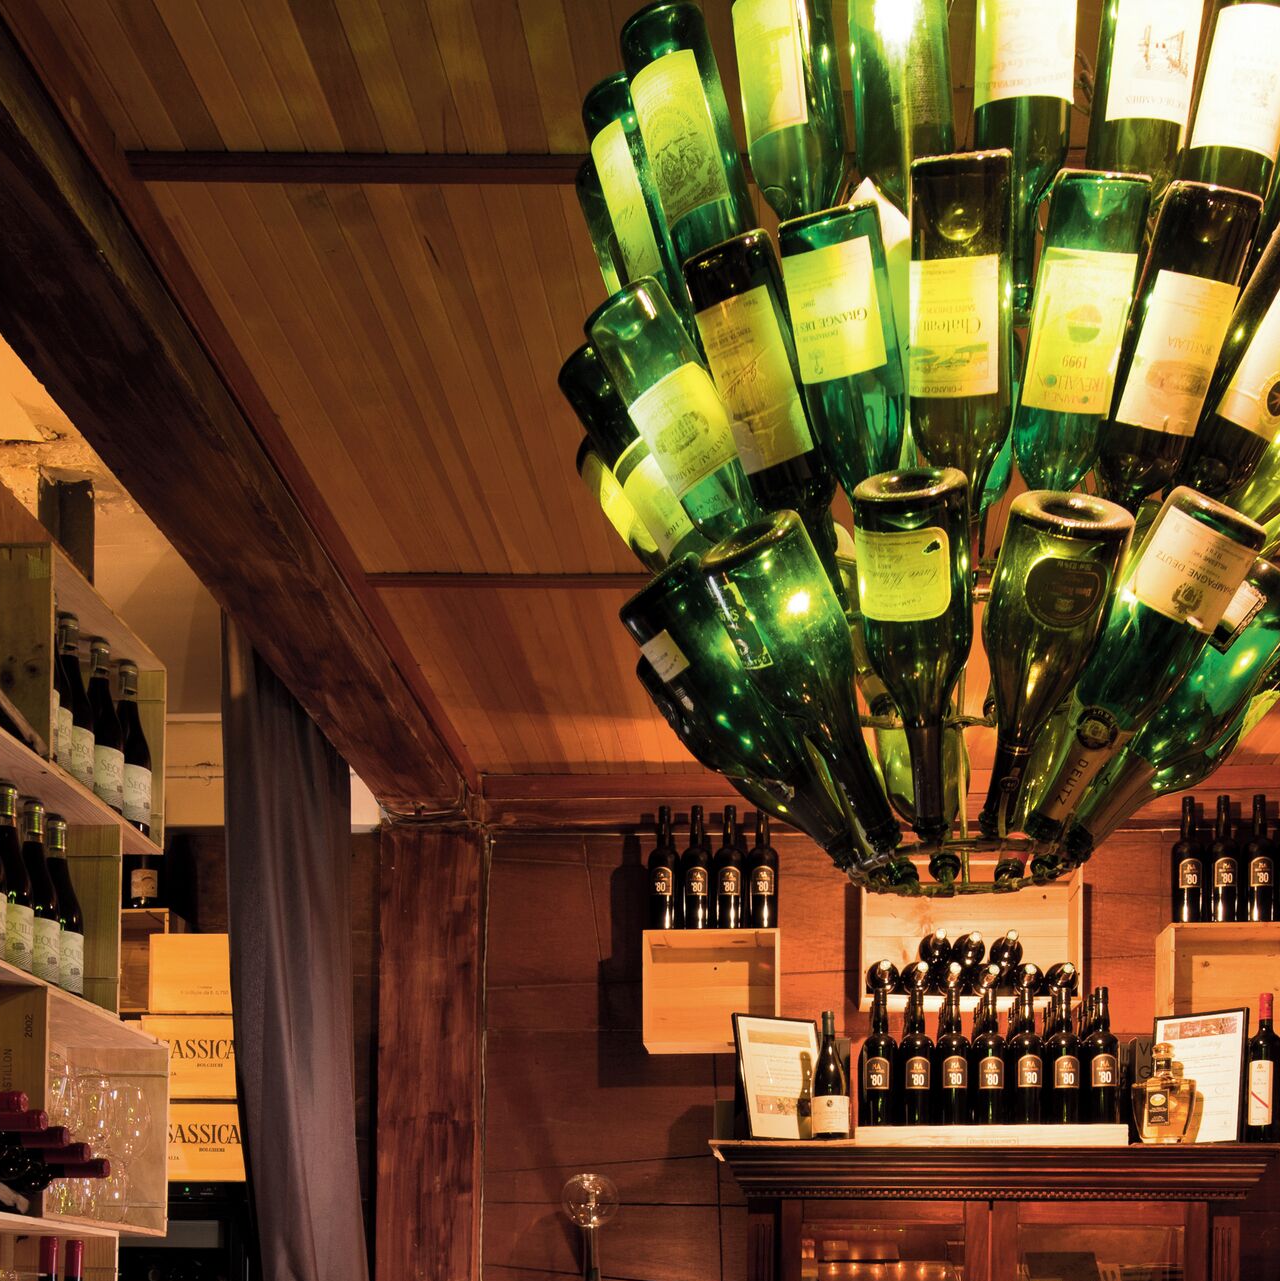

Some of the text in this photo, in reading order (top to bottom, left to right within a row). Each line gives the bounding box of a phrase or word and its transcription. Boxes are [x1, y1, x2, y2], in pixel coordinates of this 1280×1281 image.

[1061, 356, 1088, 369] 1999
[1056, 757, 1090, 806] DEUTZ
[870, 1073, 883, 1086] '80
[912, 1073, 924, 1086] '80
[950, 1072, 962, 1085] '80
[986, 1073, 999, 1086] '80
[1024, 1071, 1037, 1084] '80
[1061, 1072, 1074, 1085] '80
[1099, 1070, 1112, 1083] '80
